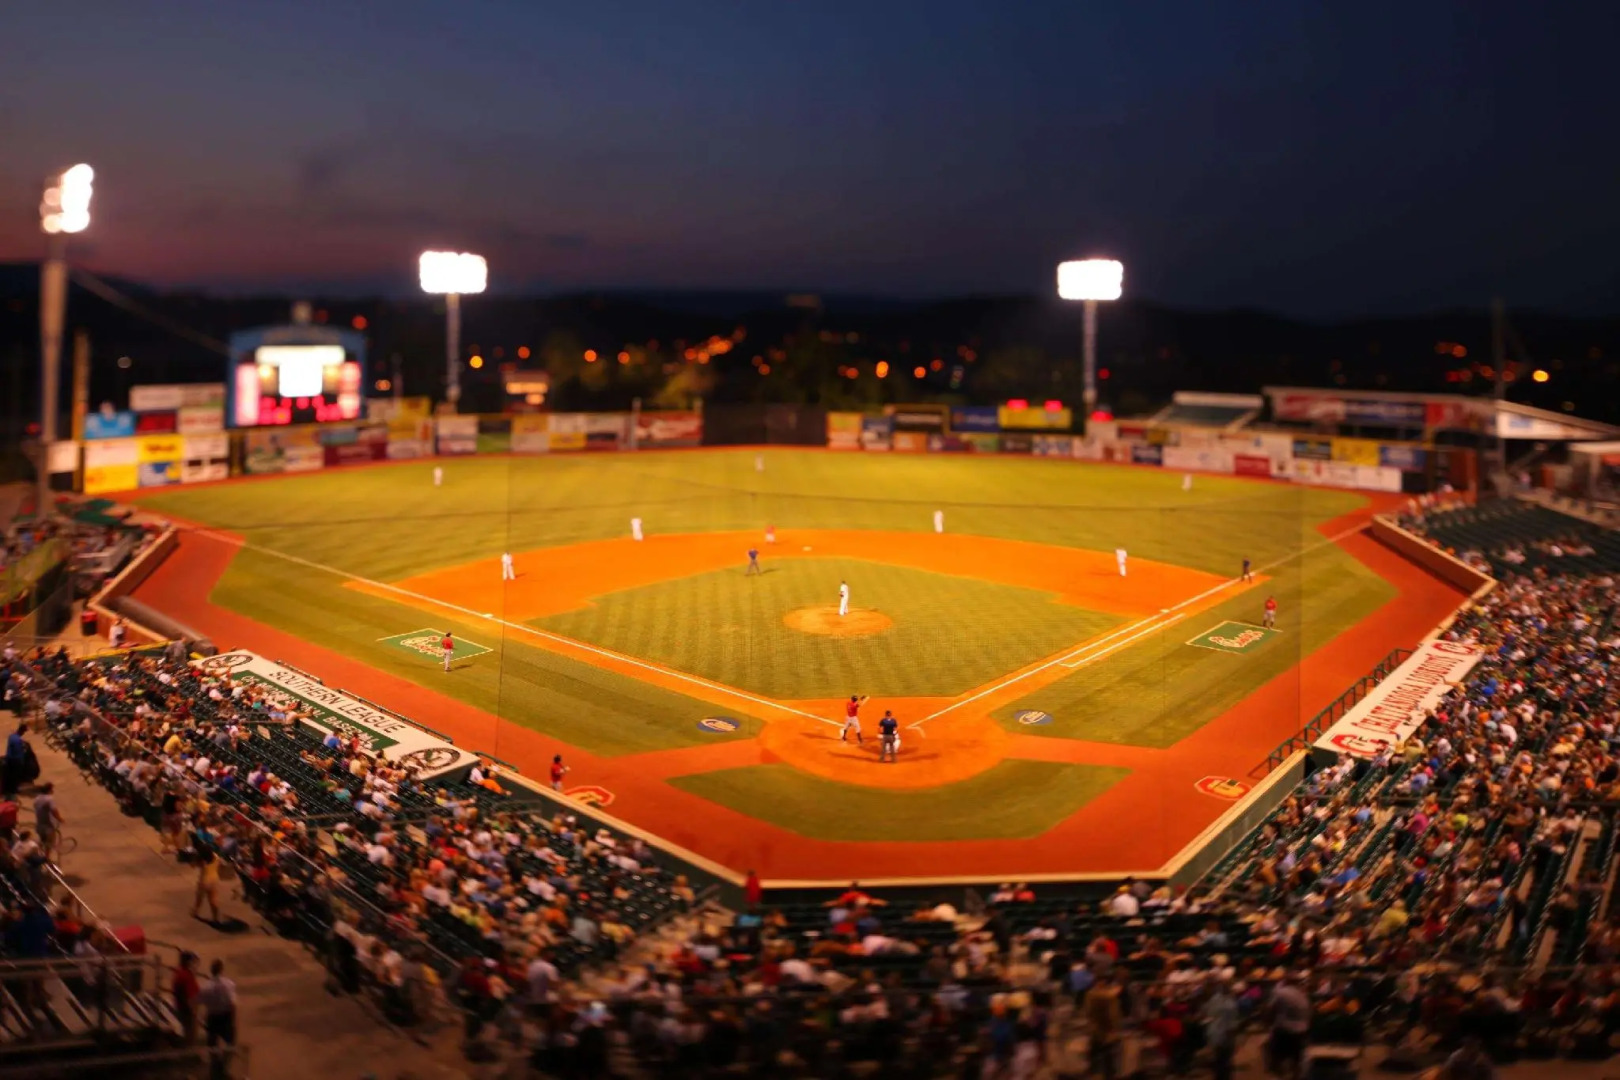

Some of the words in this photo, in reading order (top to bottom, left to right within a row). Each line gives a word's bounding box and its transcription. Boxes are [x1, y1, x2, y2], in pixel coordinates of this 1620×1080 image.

[269, 671, 343, 705] SOUTHERN
[337, 702, 407, 733] LEAGUE
[1351, 684, 1433, 735] CHATTANOOGA
[1406, 654, 1464, 684] LOOKOUTS
